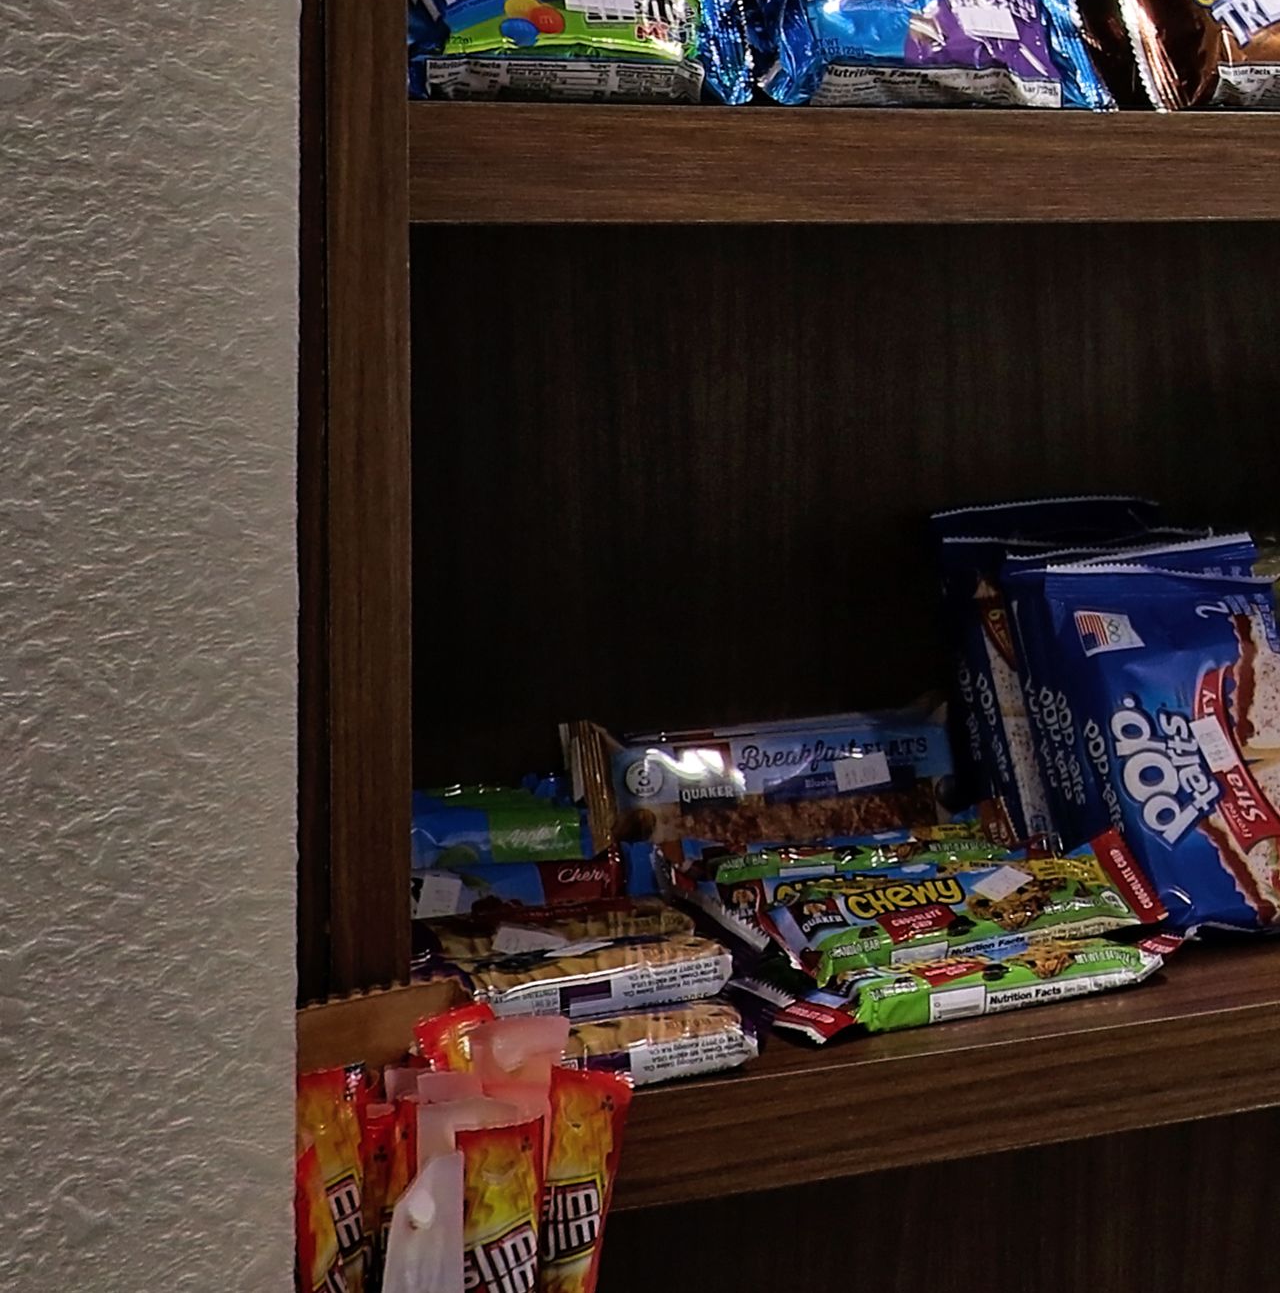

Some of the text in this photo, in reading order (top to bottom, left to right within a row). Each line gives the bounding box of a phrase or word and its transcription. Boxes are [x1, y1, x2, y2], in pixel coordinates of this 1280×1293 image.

[738, 738, 863, 774] Breakfast
[681, 786, 735, 803] QUAKER
[557, 867, 612, 886] Cherry
[1121, 865, 1154, 910] CHOCOLATE
[848, 876, 964, 920] CHEWY
[802, 915, 843, 933] QUAKER
[891, 909, 943, 927] CHOCOLATE
[864, 939, 881, 952] BAR
[989, 987, 1062, 1005] Nutrition Facts
